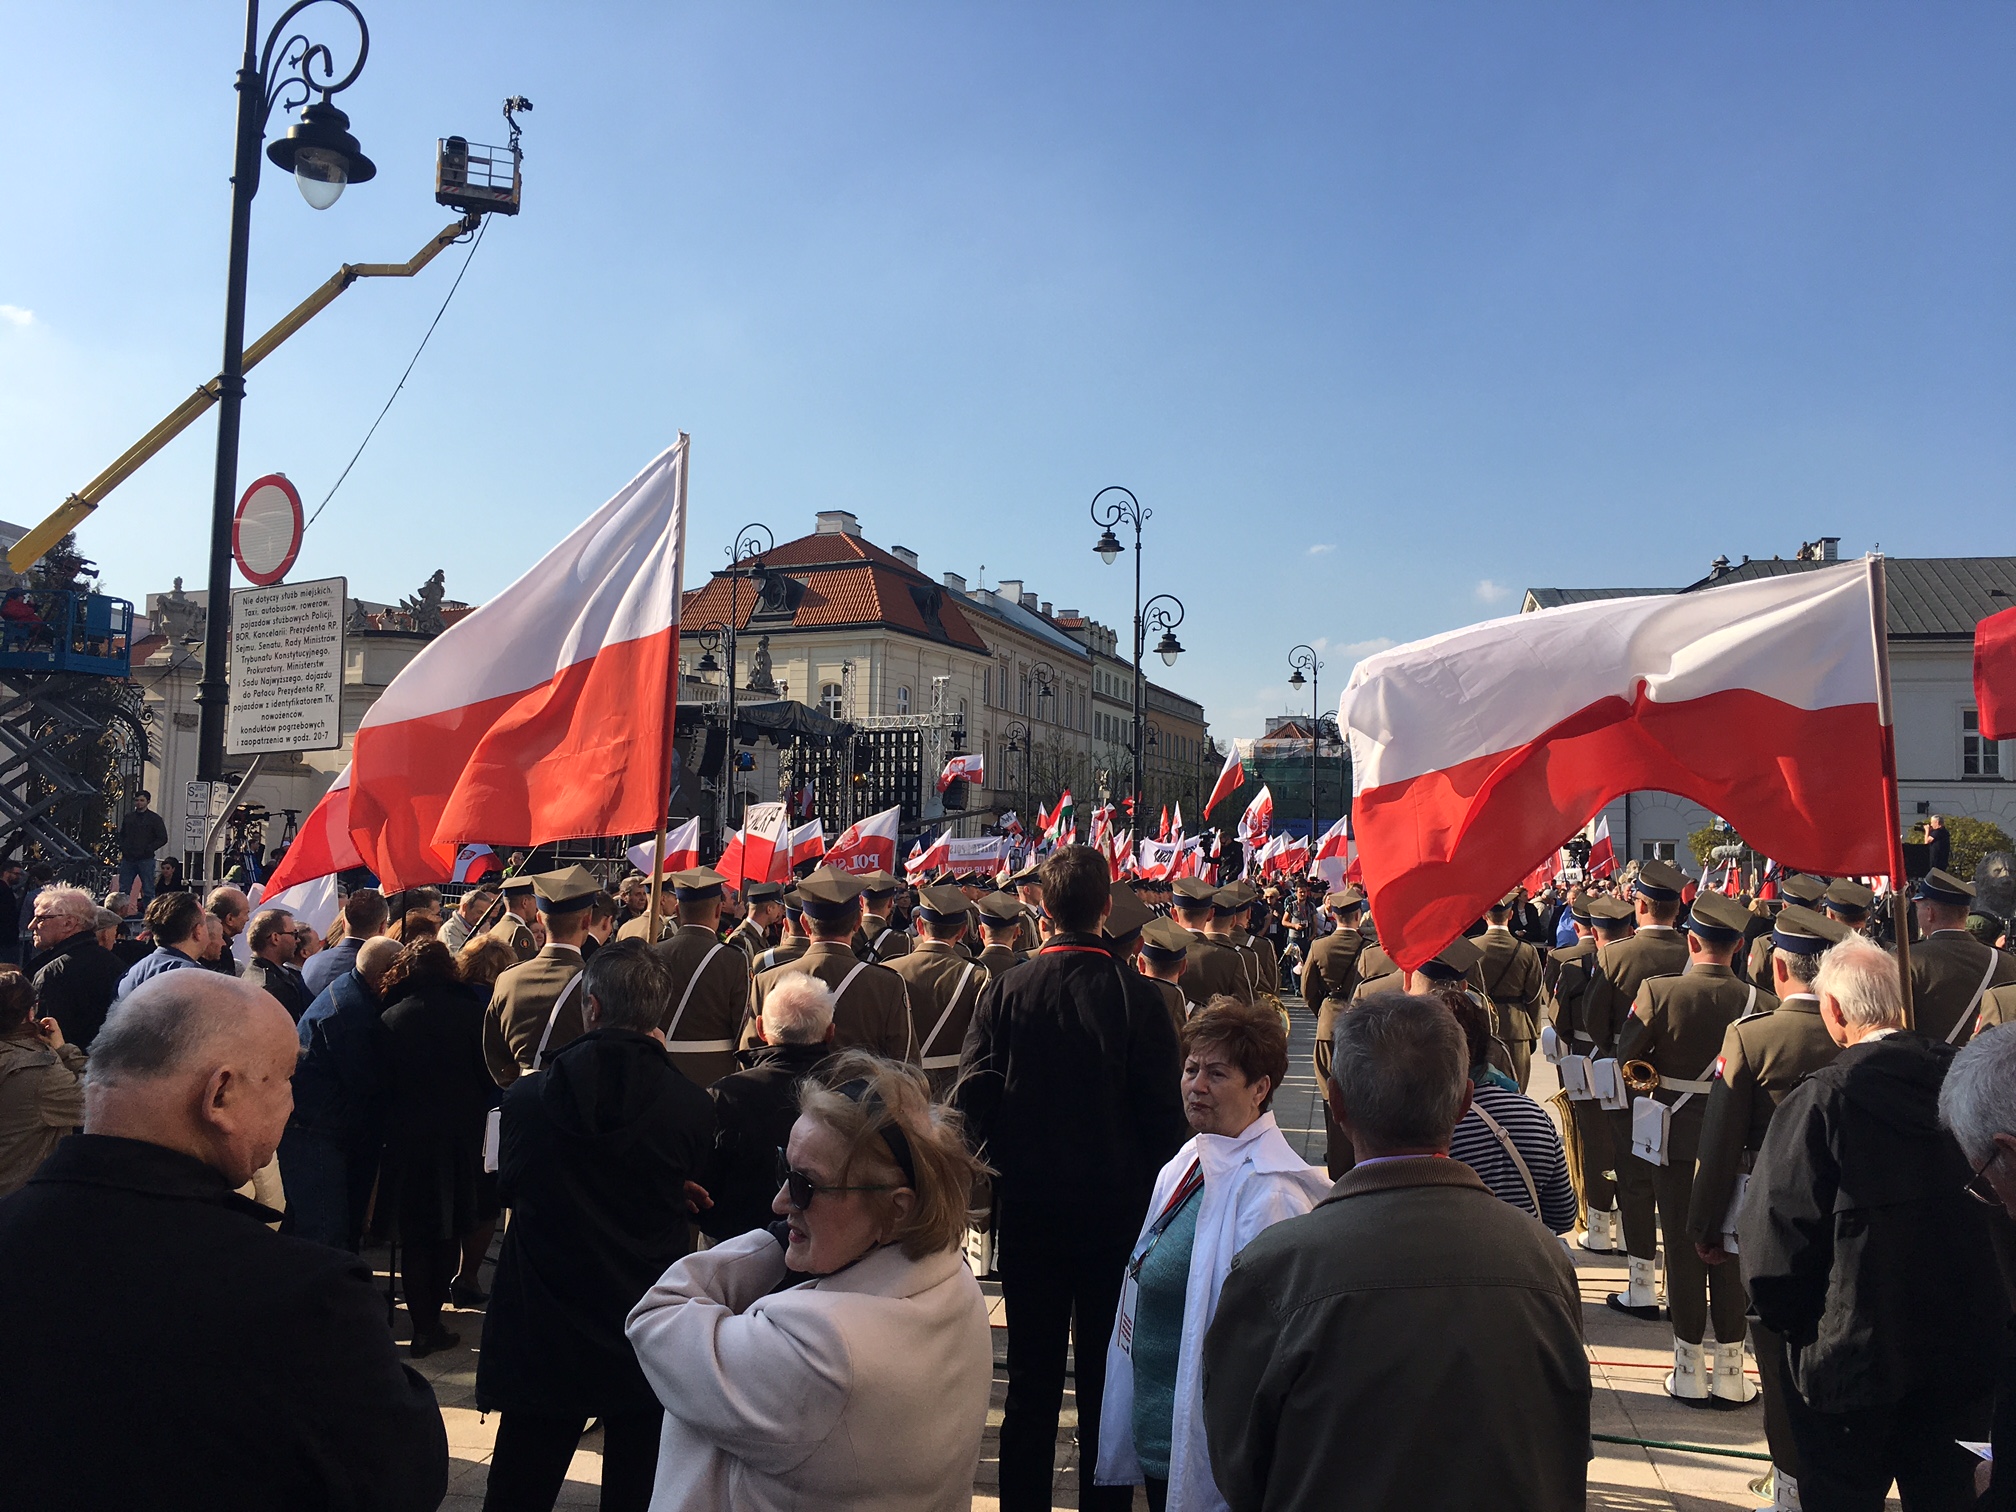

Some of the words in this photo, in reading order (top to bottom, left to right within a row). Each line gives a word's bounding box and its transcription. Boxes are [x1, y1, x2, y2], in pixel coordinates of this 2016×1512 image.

[243, 597, 253, 605] Nie
[256, 595, 279, 604] dotyczy
[290, 624, 325, 635] Prezydenta
[285, 638, 301, 647] Rady
[287, 660, 324, 670] Ministerstw
[306, 671, 332, 681] dojazdu
[278, 685, 313, 696] Prezydenta
[271, 698, 323, 708] identyfikatorem
[278, 720, 324, 733] pogrzebowych
[241, 735, 283, 746] zaopatrzenia
[314, 731, 328, 740] 20-7
